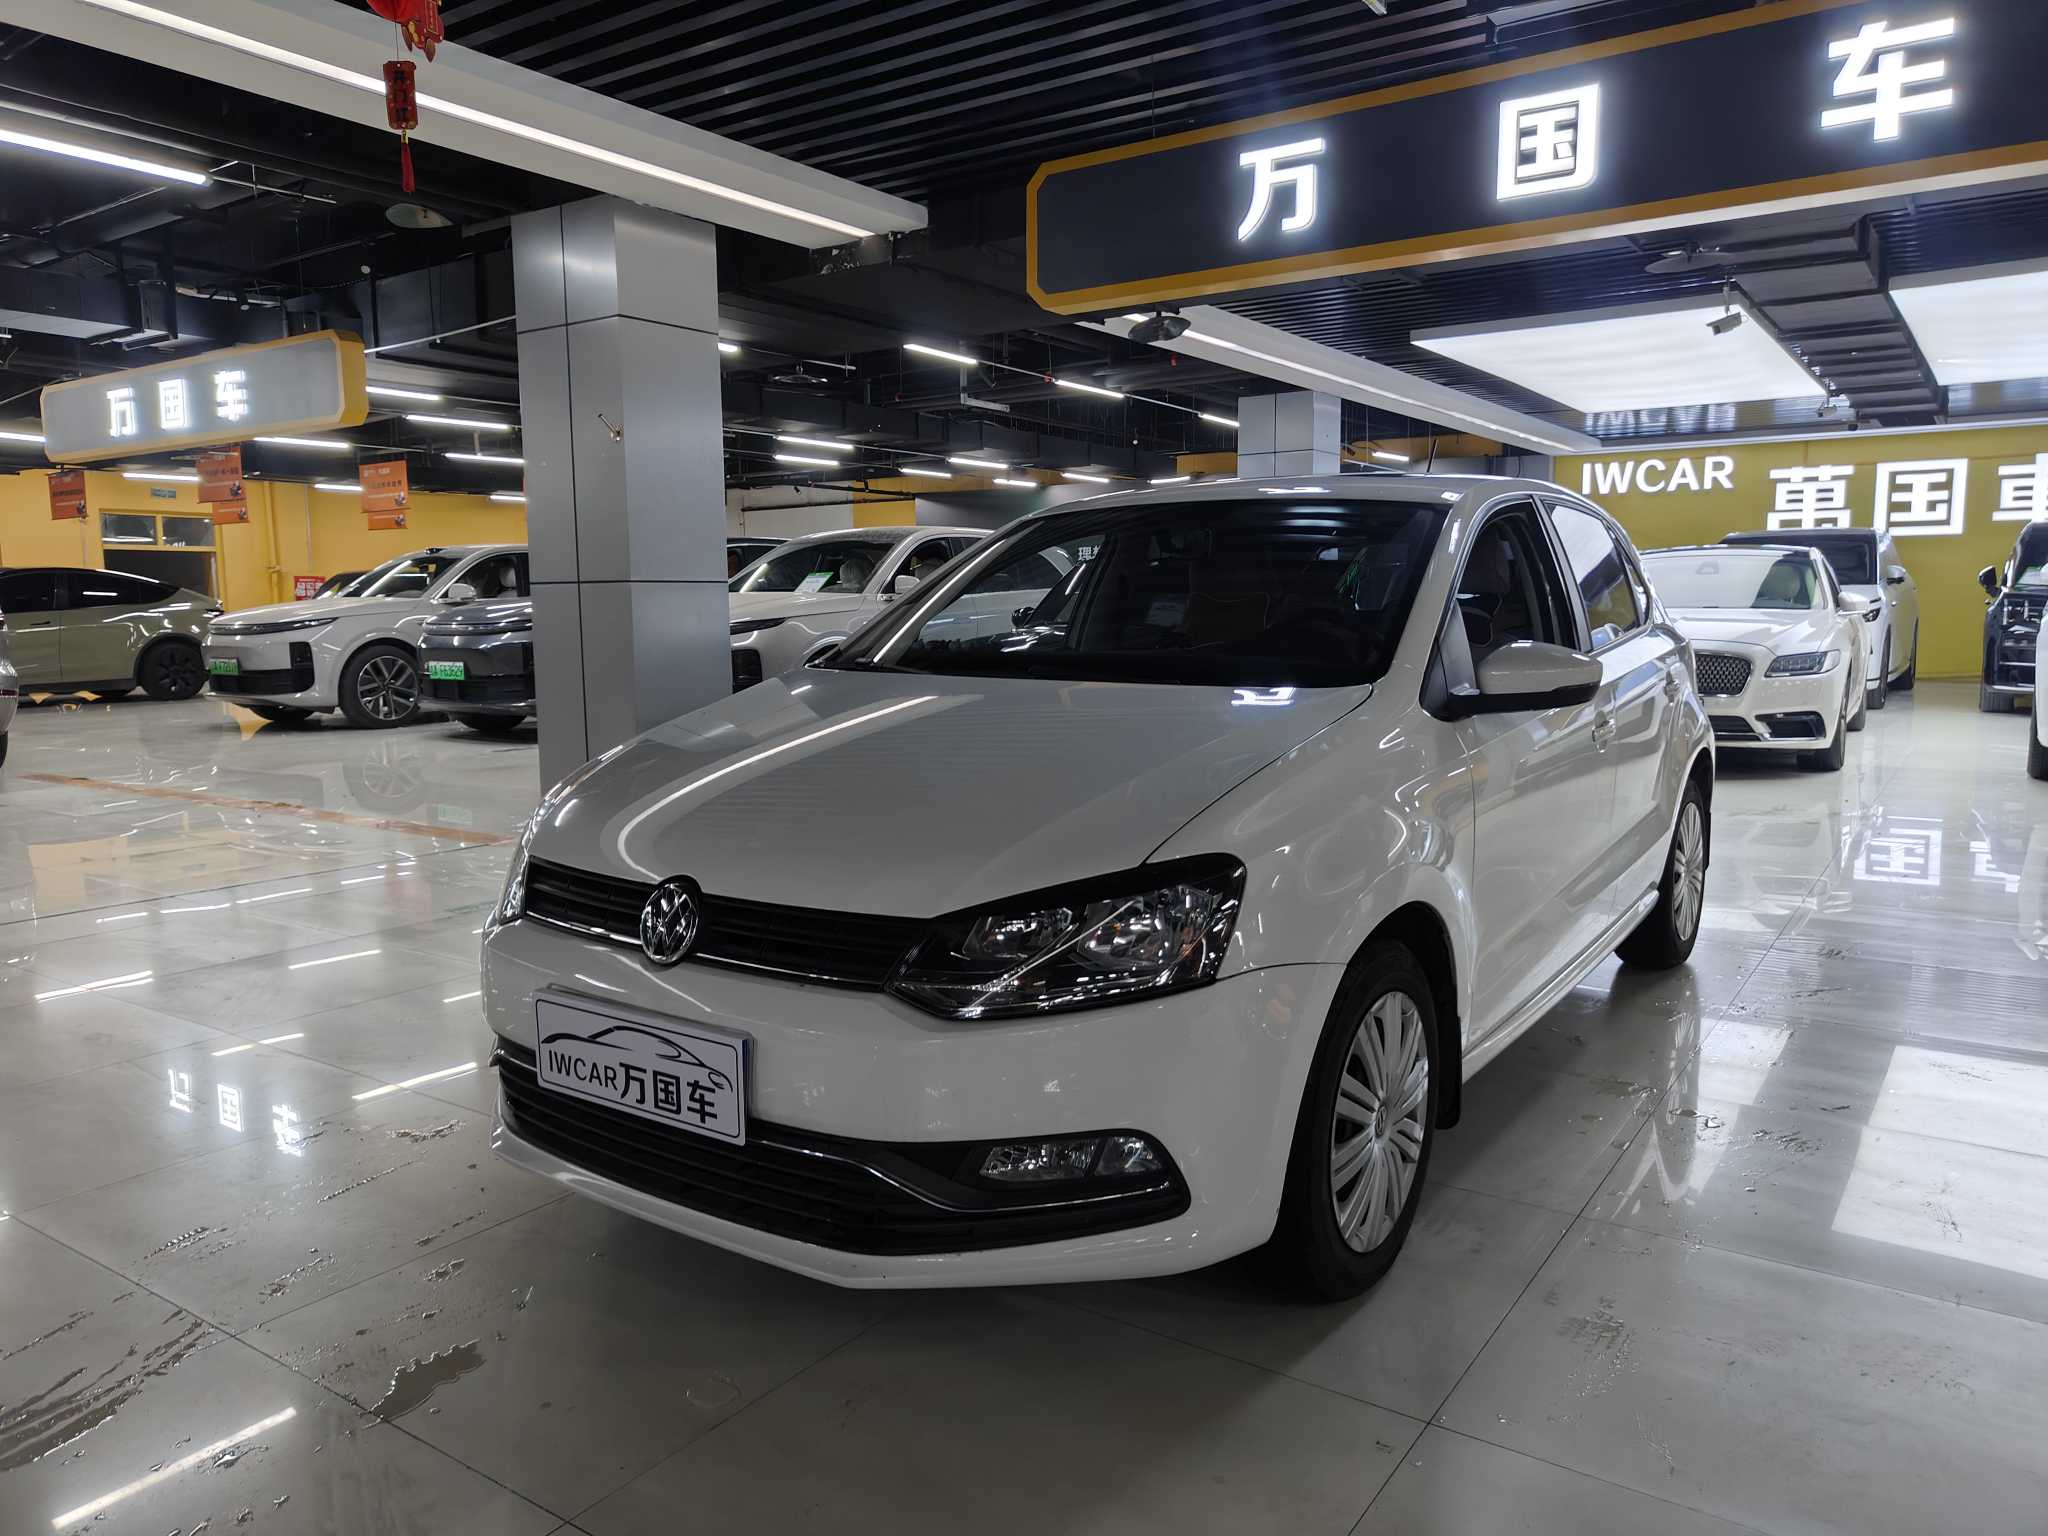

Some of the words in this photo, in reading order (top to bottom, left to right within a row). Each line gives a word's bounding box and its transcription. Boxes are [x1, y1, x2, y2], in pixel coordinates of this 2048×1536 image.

[1237, 17, 1956, 242] 万国车
[106, 369, 248, 438] 万国车
[1581, 455, 1735, 496] IWCAR
